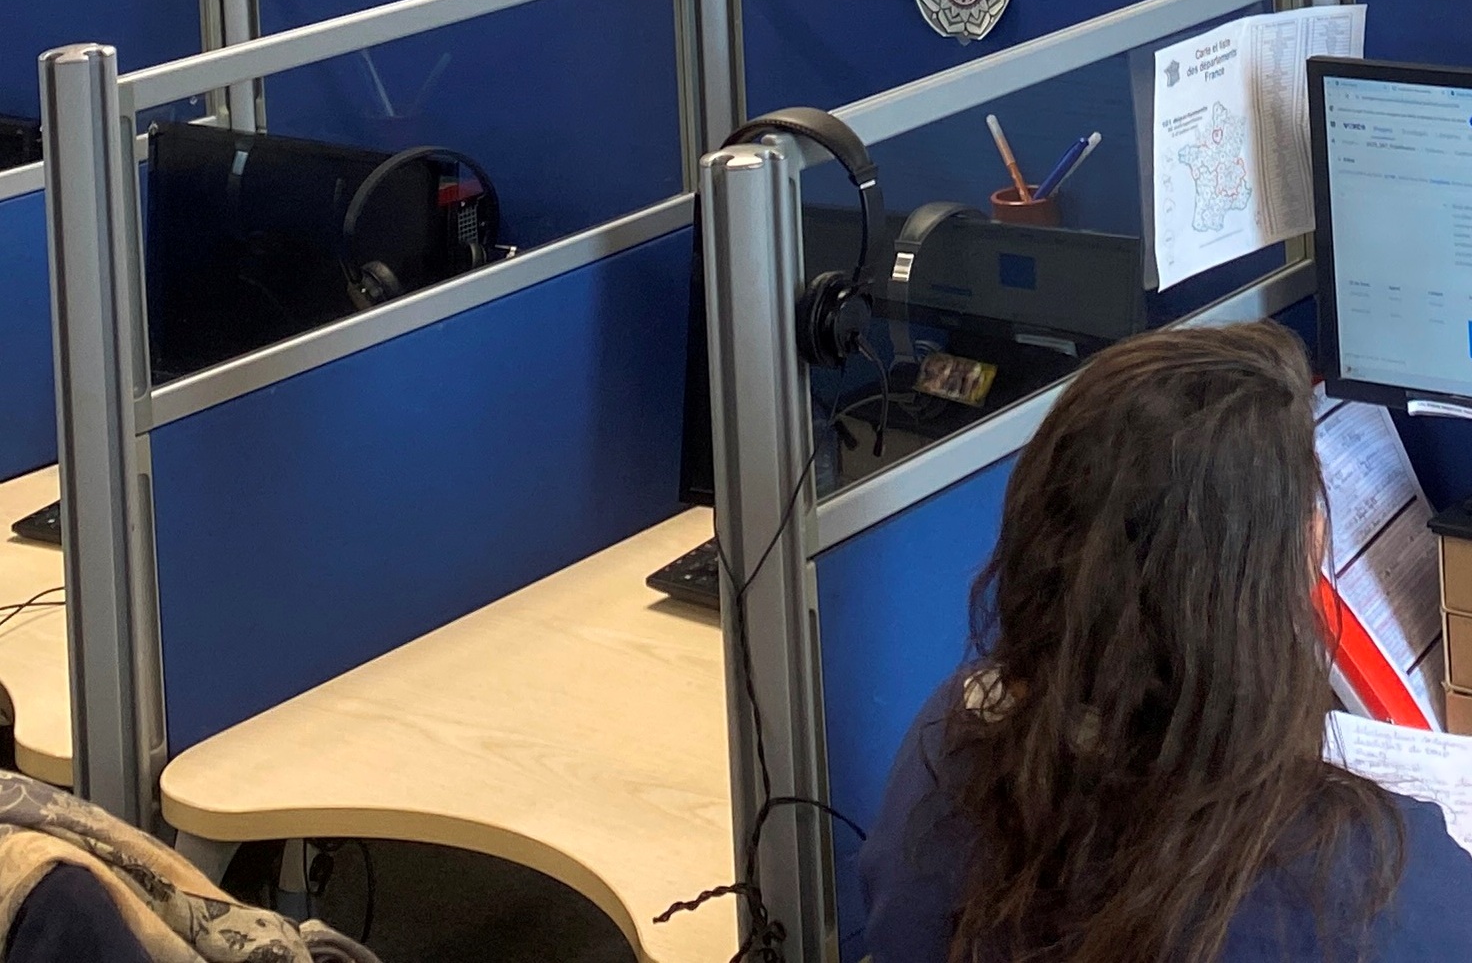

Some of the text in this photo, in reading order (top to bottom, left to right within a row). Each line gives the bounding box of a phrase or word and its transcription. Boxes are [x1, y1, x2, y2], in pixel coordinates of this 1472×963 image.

[1196, 38, 1231, 60] Carte et liste
[1187, 49, 1237, 77] des départements
[1204, 67, 1225, 82] France
